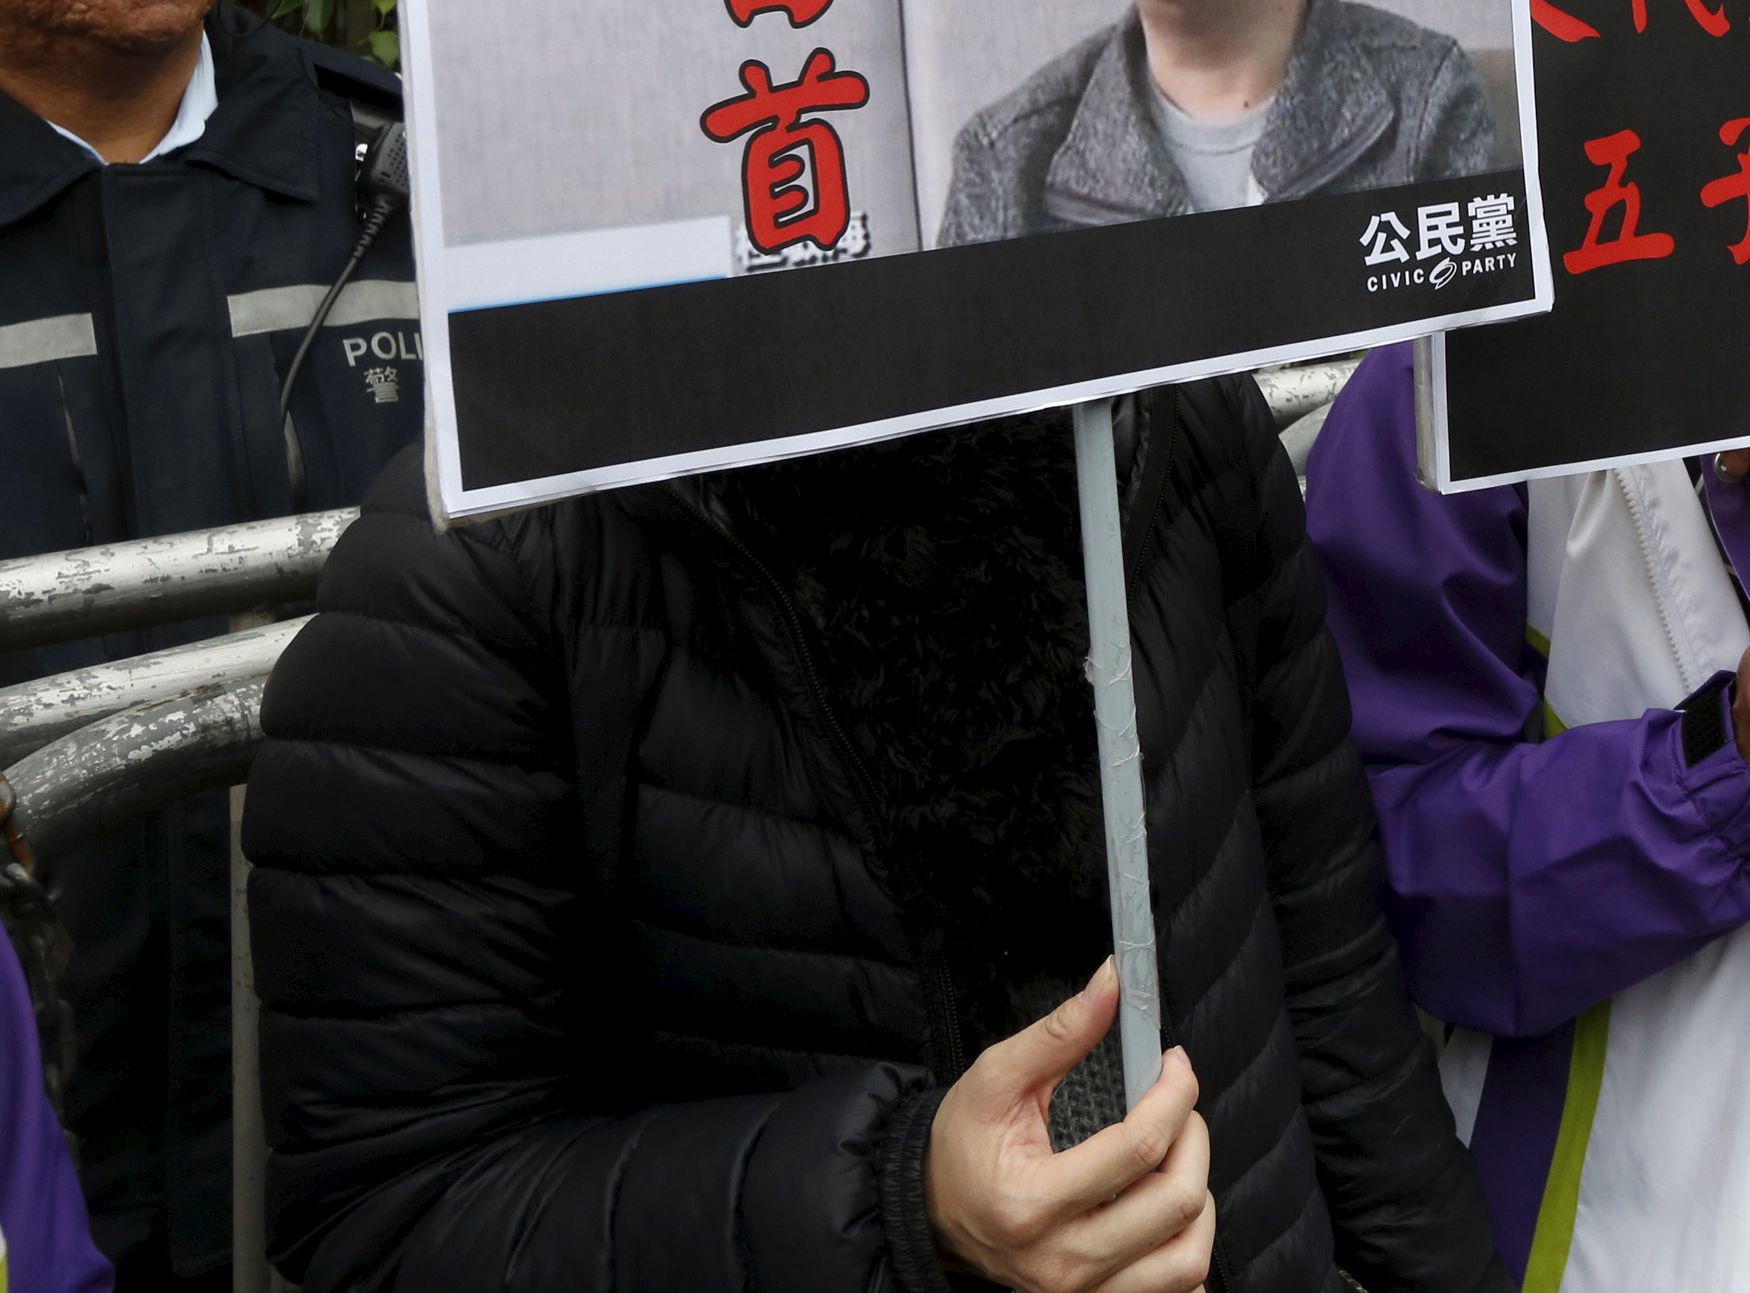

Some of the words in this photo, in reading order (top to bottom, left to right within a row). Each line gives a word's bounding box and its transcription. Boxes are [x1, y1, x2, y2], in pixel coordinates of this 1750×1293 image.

[1359, 193, 1518, 266] 公民黨
[1366, 268, 1425, 293] CIVIC
[1461, 252, 1517, 276] PARTY
[363, 366, 400, 404] 警
